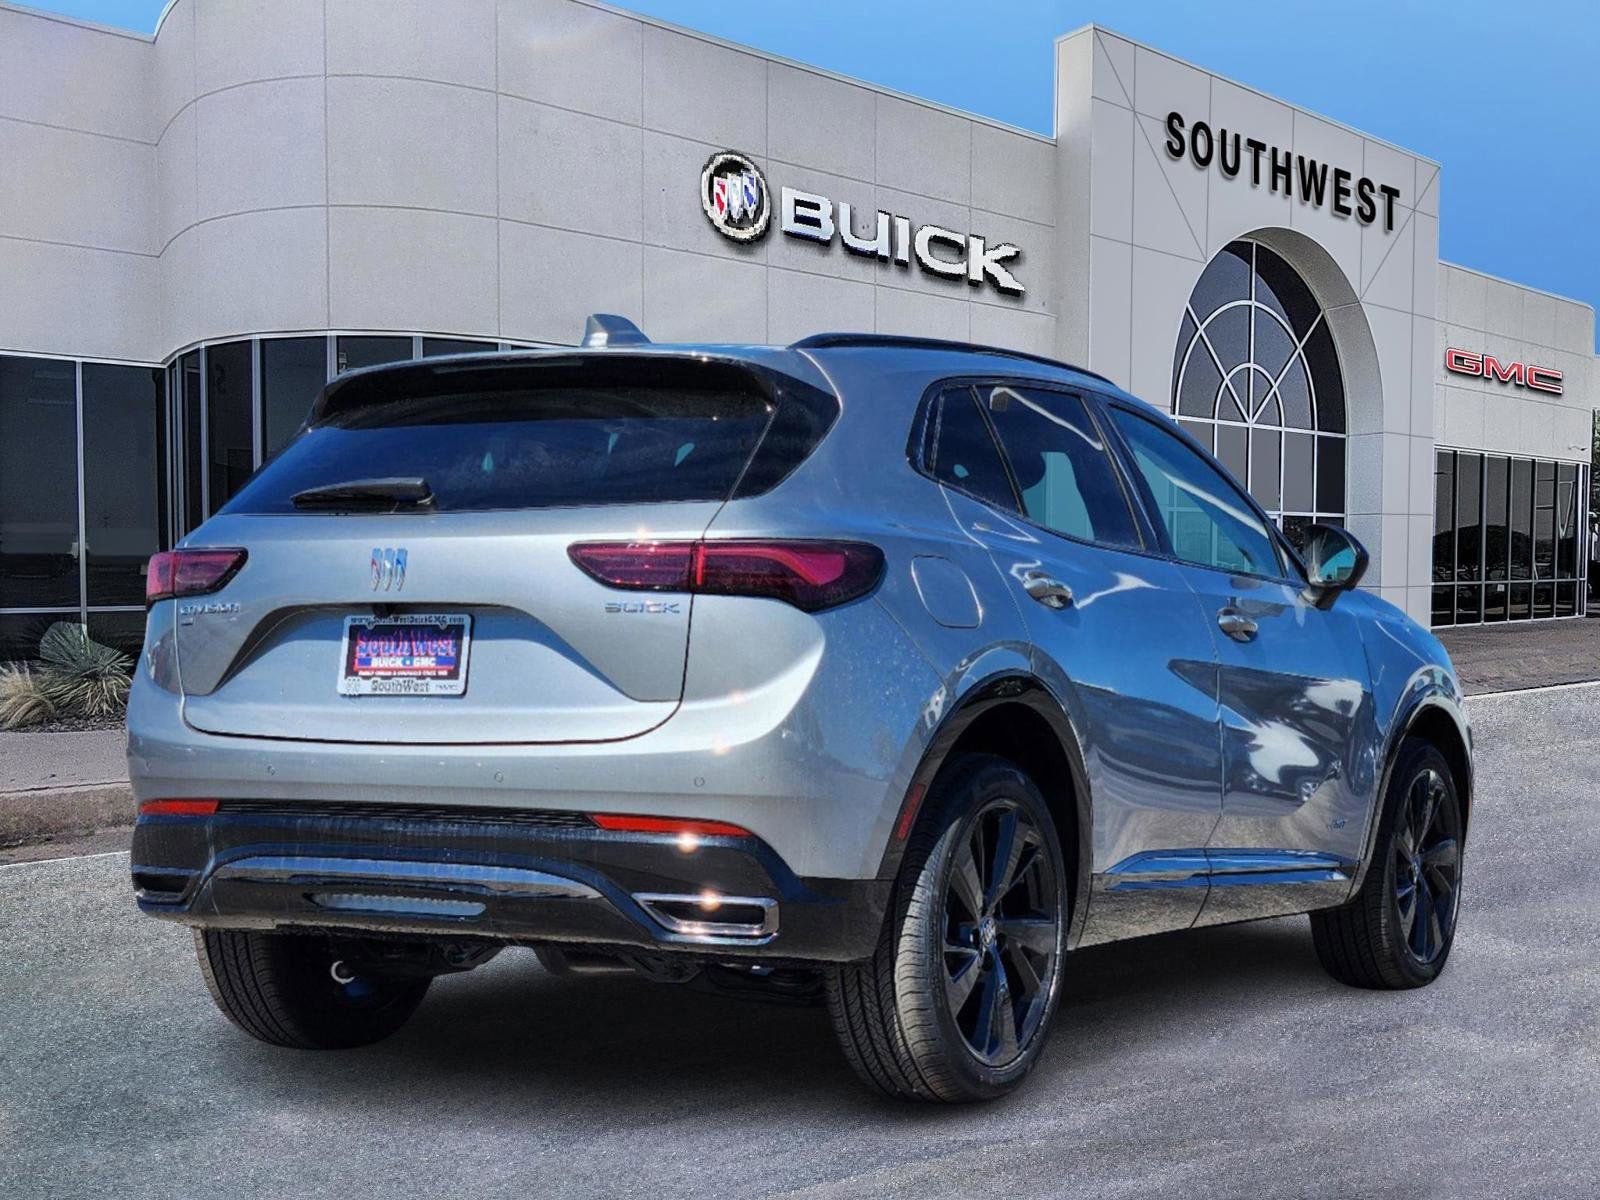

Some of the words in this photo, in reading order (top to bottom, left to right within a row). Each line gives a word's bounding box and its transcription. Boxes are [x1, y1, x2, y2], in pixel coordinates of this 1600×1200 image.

[1166, 111, 1401, 233] SOUTHWEST
[781, 186, 1026, 296] BUICK
[1446, 347, 1563, 395] GMC
[605, 602, 680, 614] BUICK
[370, 656, 403, 667] BUICK
